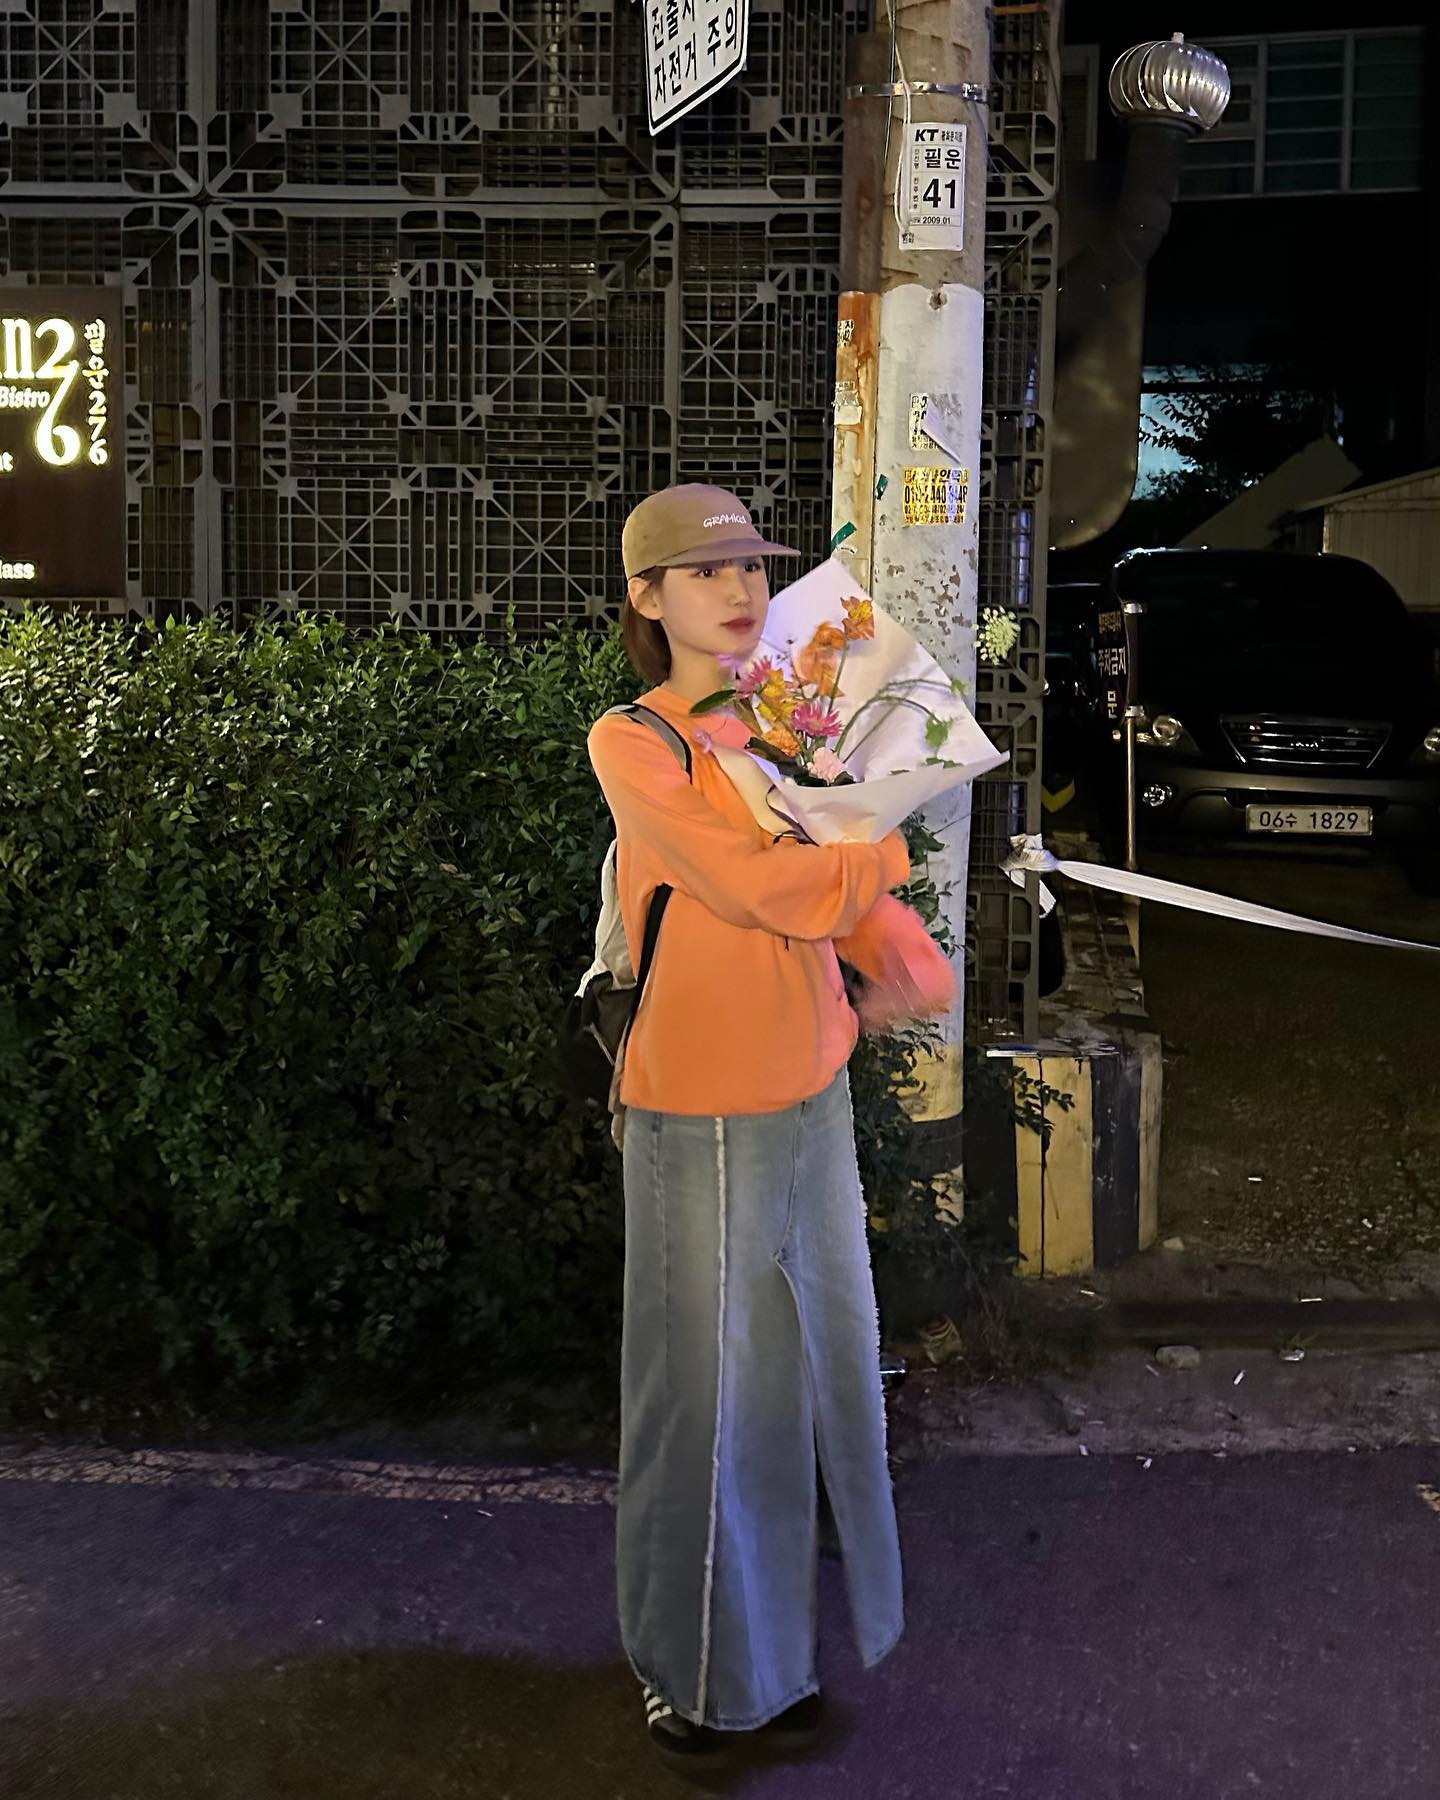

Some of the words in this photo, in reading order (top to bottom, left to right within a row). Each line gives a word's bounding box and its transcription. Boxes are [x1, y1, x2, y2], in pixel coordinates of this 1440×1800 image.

[654, 32, 697, 104] 자전거
[707, 0, 737, 67] 주의
[915, 129, 939, 142] KT
[925, 148, 961, 170] 필운
[922, 178, 956, 209] 41
[922, 216, 951, 225] 2009.01
[0, 386, 50, 408] Bistro
[1098, 647, 1126, 677] 주차금지
[1259, 812, 1298, 829] 06수
[1310, 812, 1359, 830] 1829
